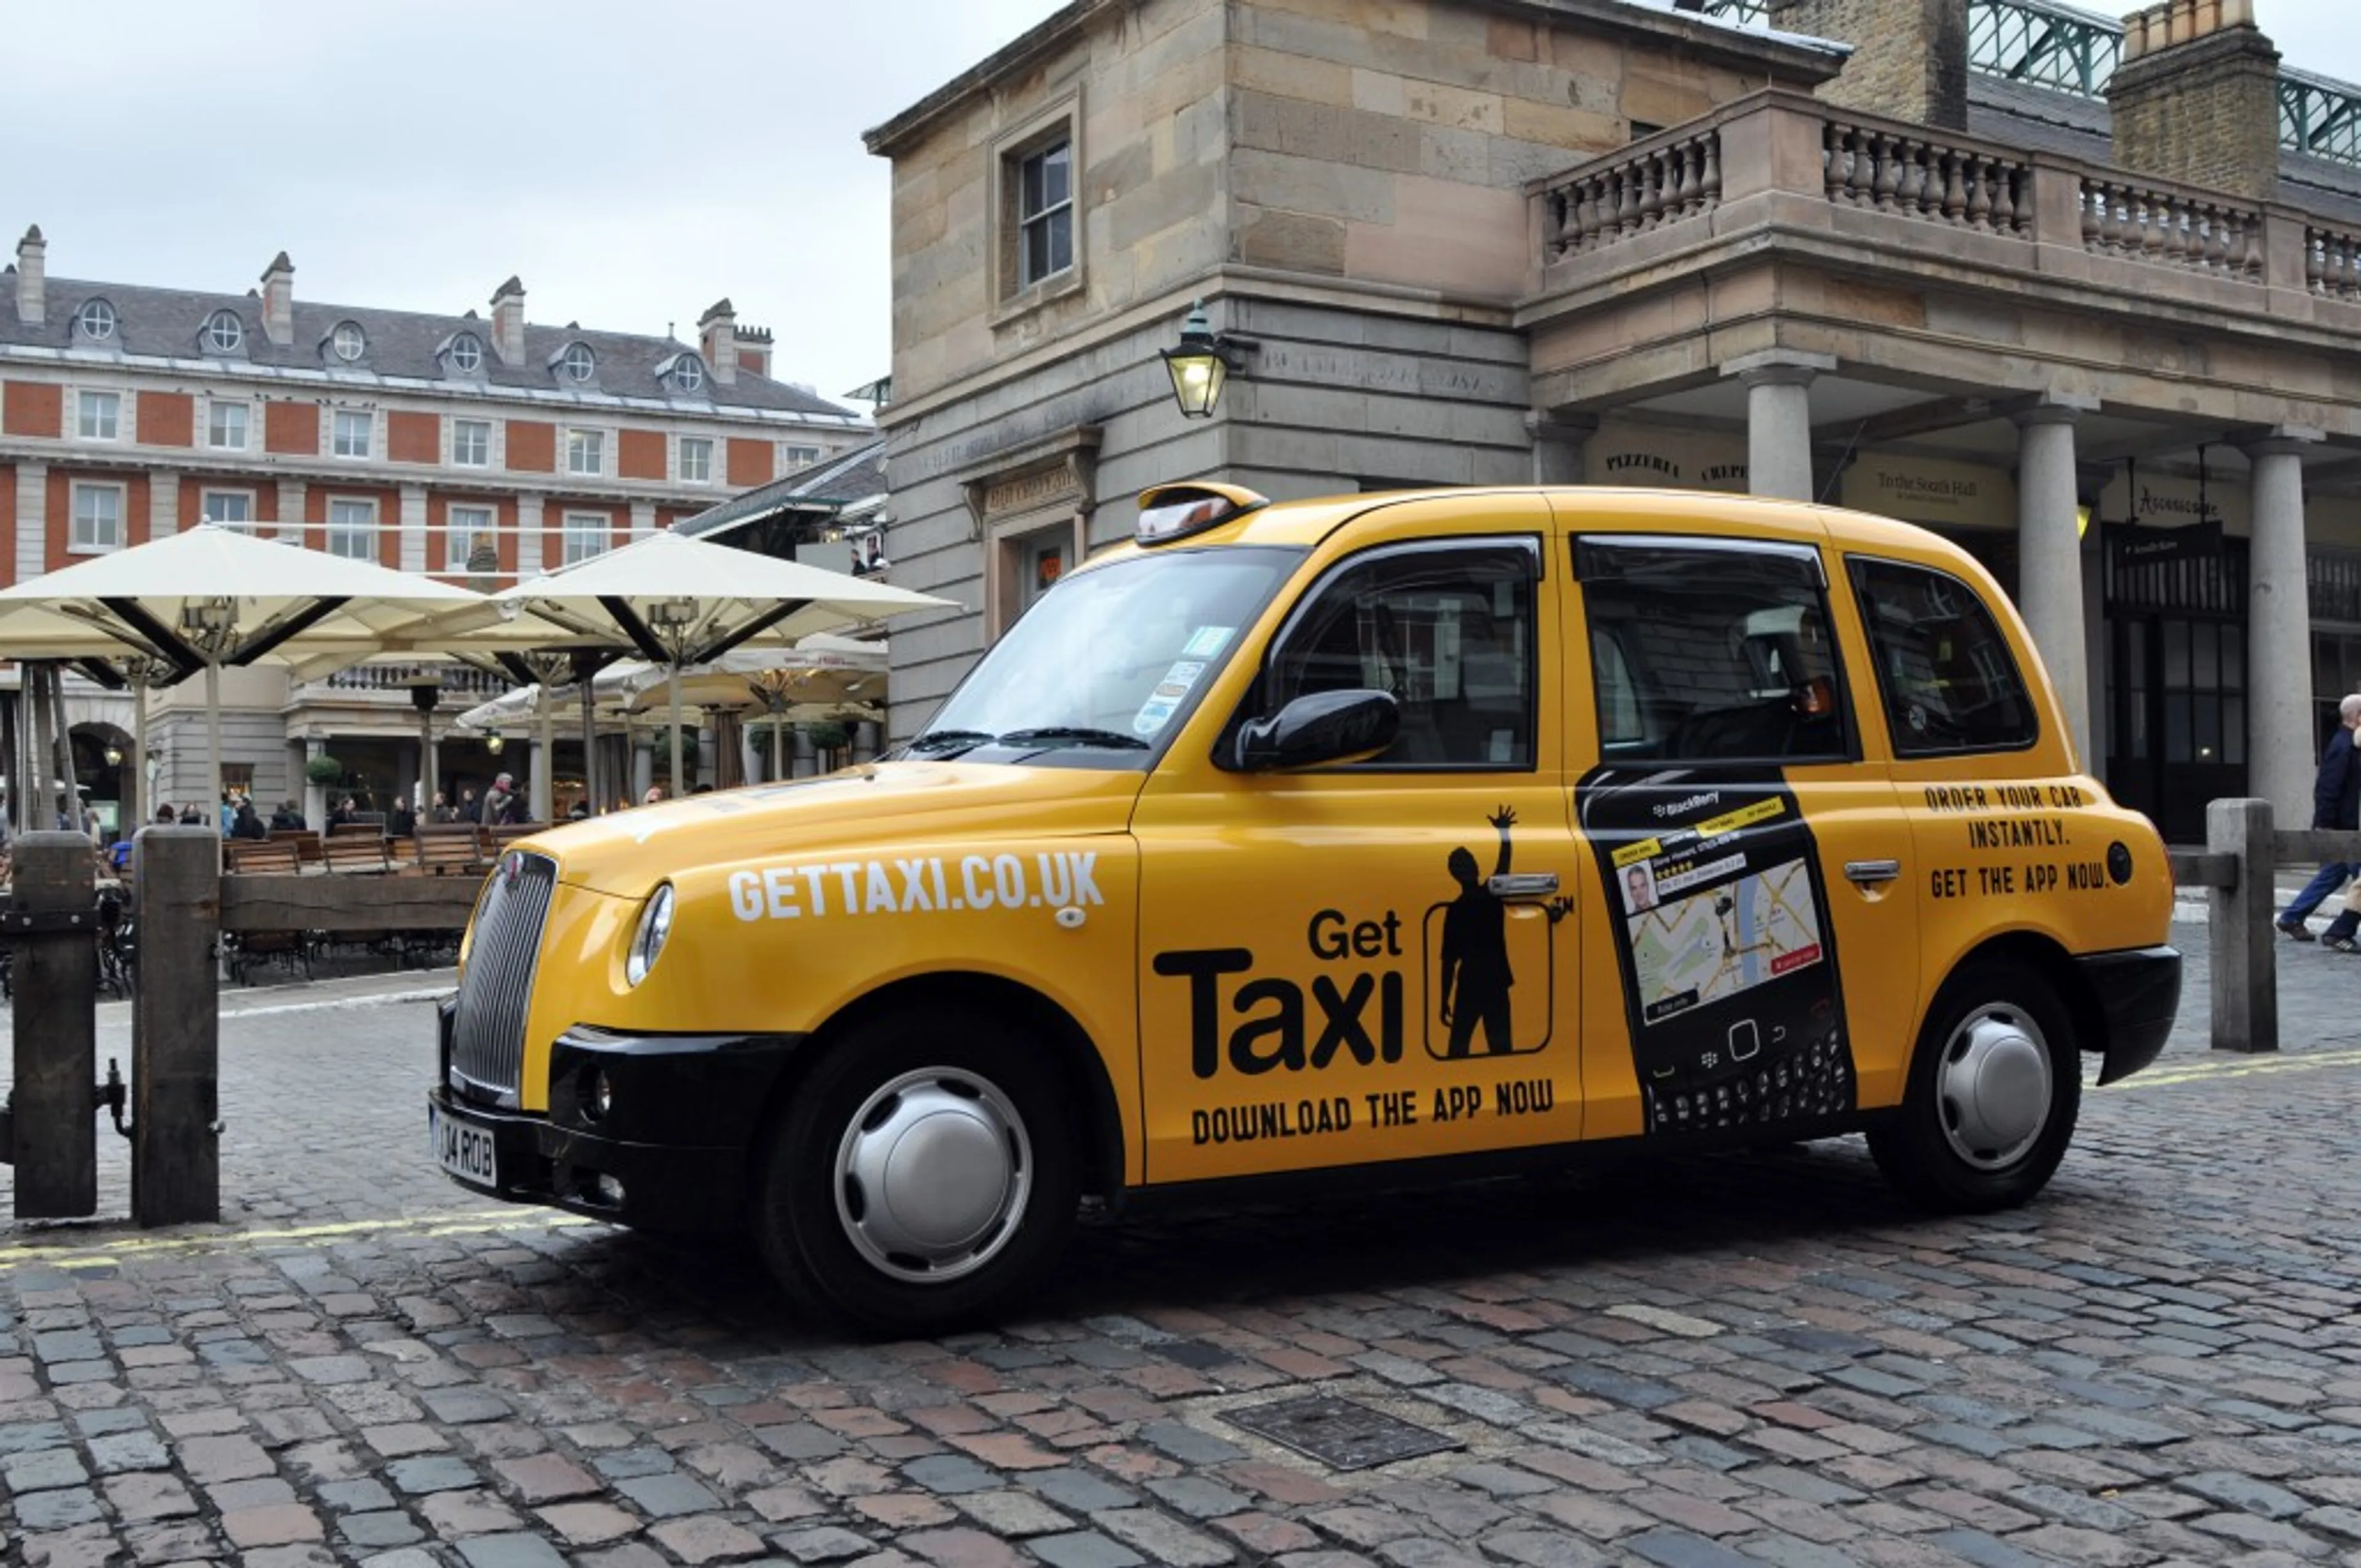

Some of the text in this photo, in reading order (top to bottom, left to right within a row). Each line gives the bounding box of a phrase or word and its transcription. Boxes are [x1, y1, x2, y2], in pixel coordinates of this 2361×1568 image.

[1924, 786, 2083, 812] ORDER YOUR CAB
[1969, 819, 2071, 849] INSTANTLY.
[728, 852, 1105, 922] GETTAXI.CO.UK
[1931, 862, 2111, 898] GET THE APP NOW.
[1308, 909, 1402, 960] Get
[1152, 948, 1404, 1079] Taxi
[1193, 1079, 1554, 1145] DOWNLOAD THE APP NOW
